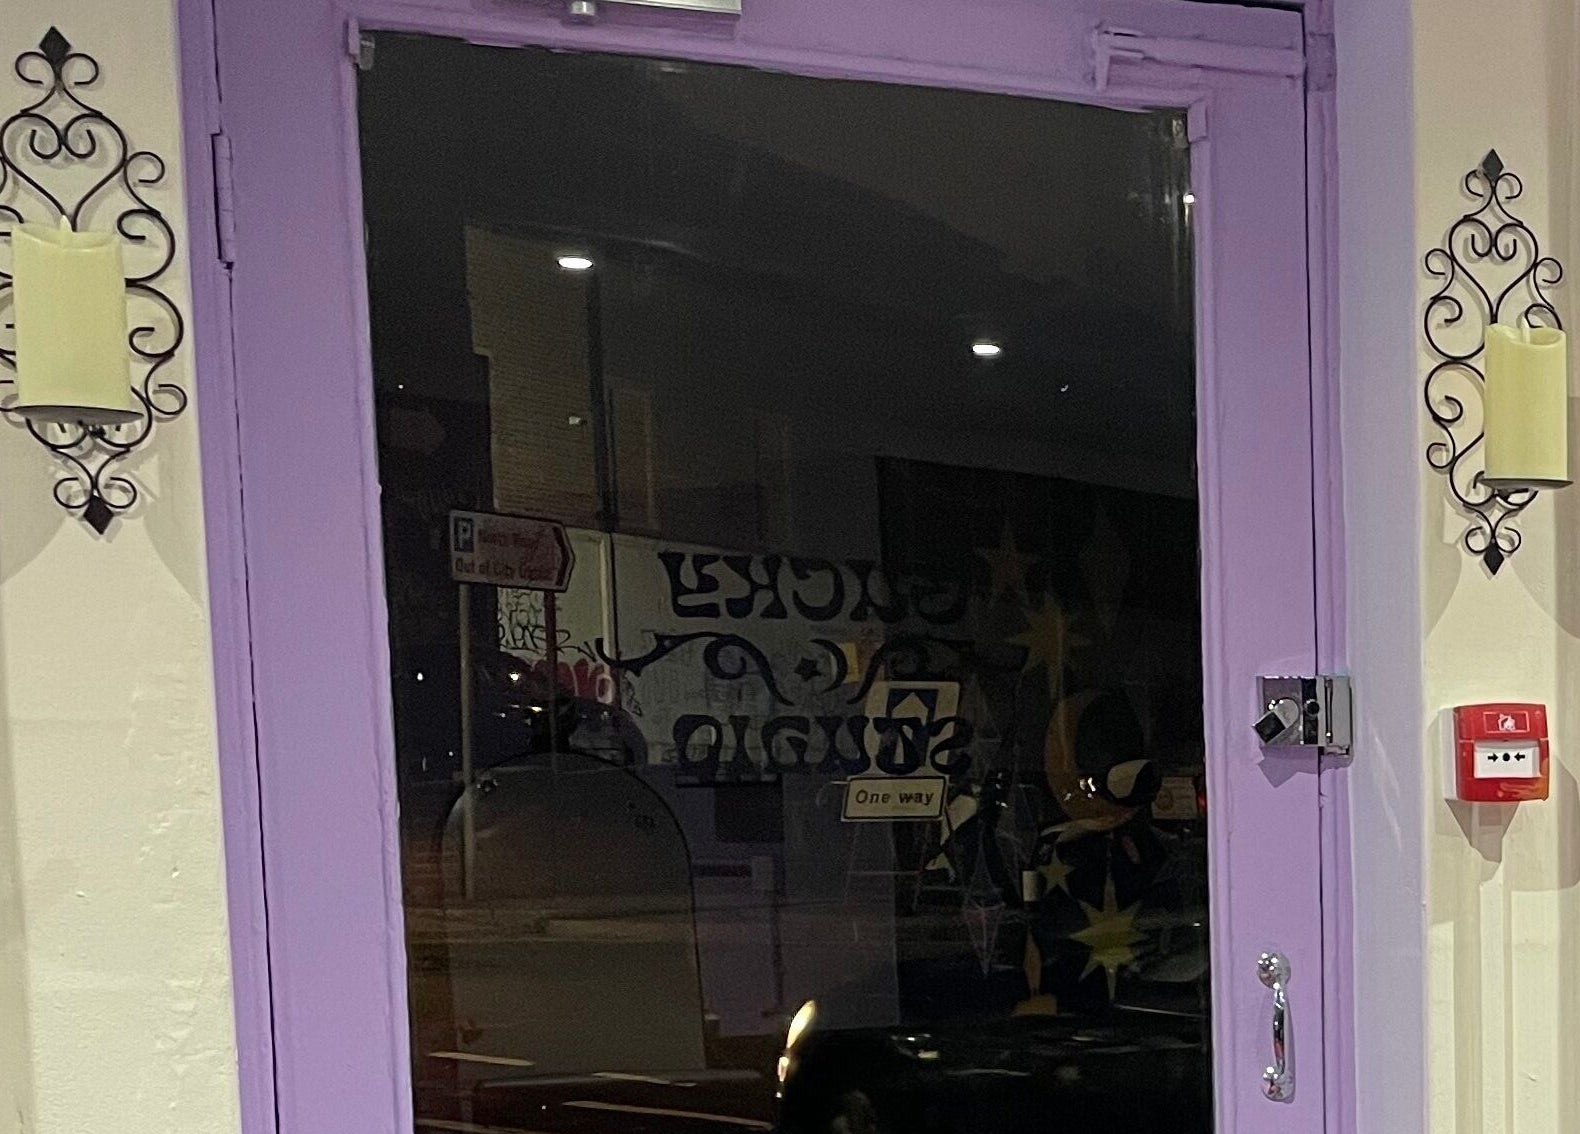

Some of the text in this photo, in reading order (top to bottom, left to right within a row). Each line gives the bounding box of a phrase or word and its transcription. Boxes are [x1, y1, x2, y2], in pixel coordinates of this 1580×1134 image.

[458, 521, 471, 549] P
[855, 788, 935, 806] One way
